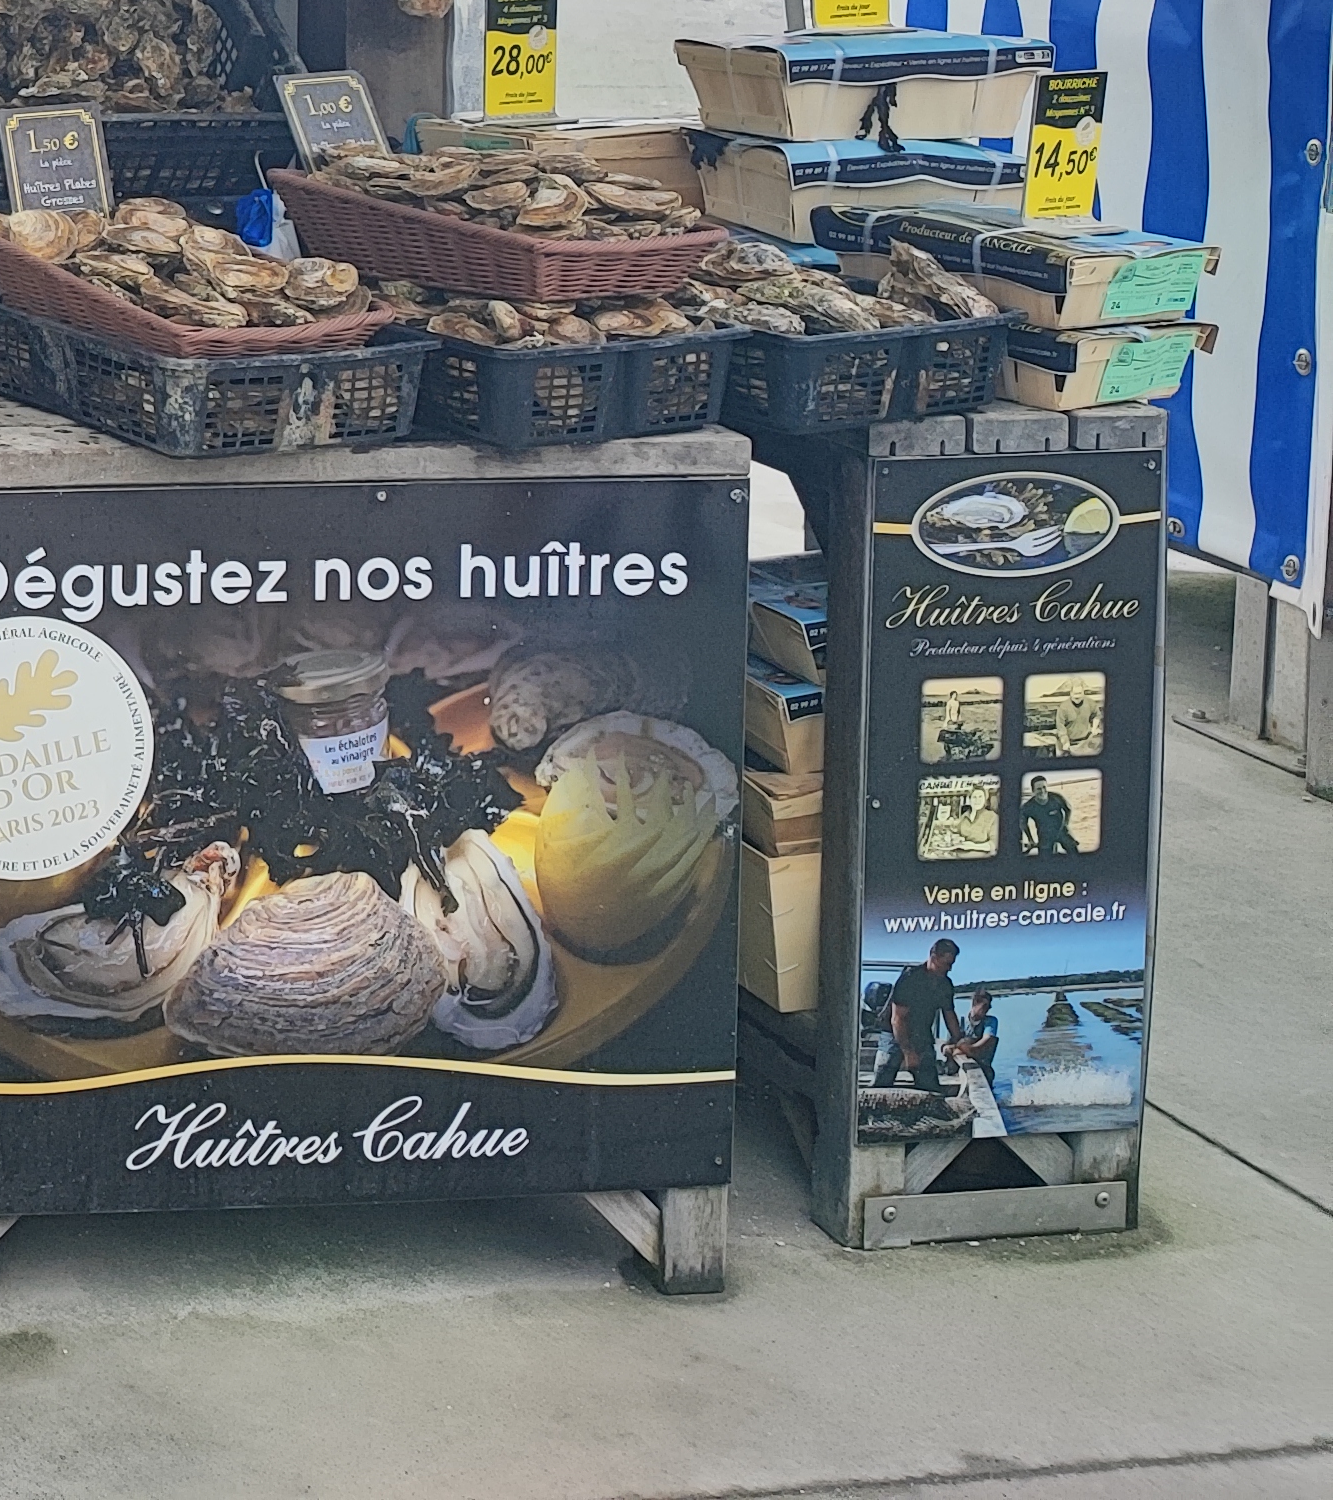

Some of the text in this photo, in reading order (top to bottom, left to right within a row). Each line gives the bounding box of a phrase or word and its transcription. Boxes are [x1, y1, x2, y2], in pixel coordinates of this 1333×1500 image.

[1049, 77, 1099, 90] BOURRICHE
[23, 178, 96, 195] Huîtres Plates
[899, 221, 972, 244] Producteur de
[314, 554, 432, 601] nos
[459, 540, 689, 598] huîtres
[886, 579, 1141, 630] Huîtres Cahue
[38, 627, 103, 663] AGRICOLE
[909, 637, 986, 657] Producteur
[988, 637, 1028, 657] depuis
[1041, 635, 1116, 655] générations
[50, 799, 101, 828] 2023
[883, 903, 1126, 934] www.huitres-cancale.fr
[126, 1096, 530, 1171] Huîtres Cahue
